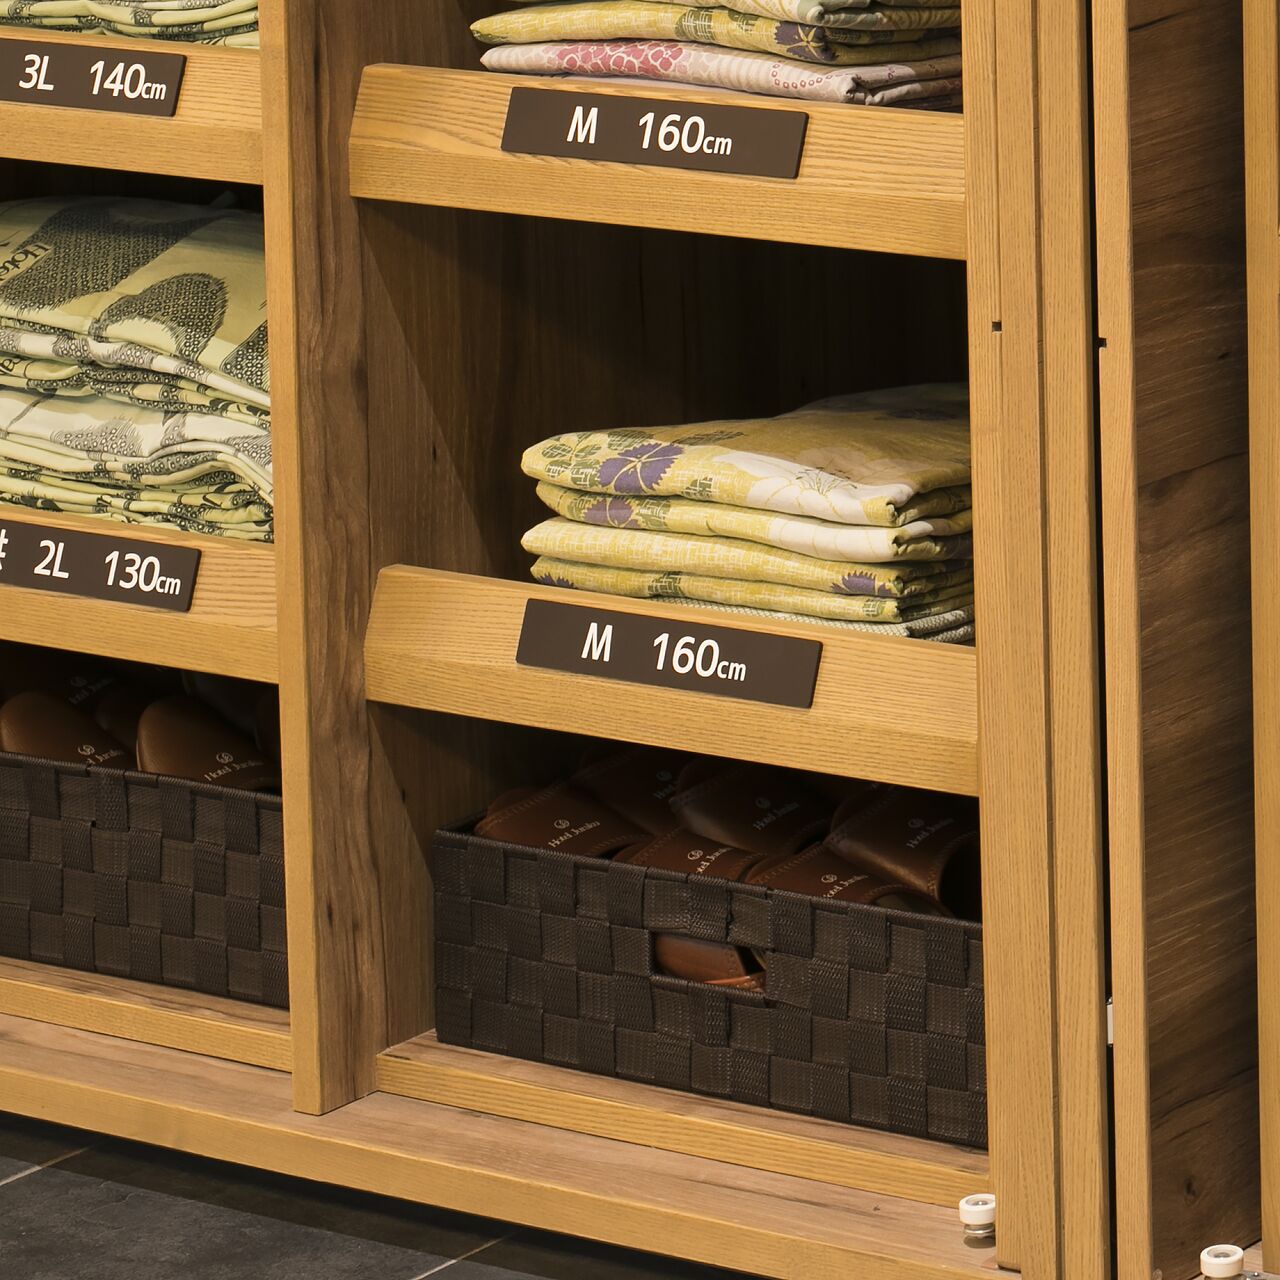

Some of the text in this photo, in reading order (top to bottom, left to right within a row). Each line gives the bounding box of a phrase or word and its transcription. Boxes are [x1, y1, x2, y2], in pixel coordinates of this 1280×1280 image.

[18, 53, 167, 101] 3L 140cm
[566, 105, 733, 156] M 160cm
[33, 539, 70, 579] 2L
[104, 550, 181, 596] 130cm
[581, 622, 747, 682] M 160cm
